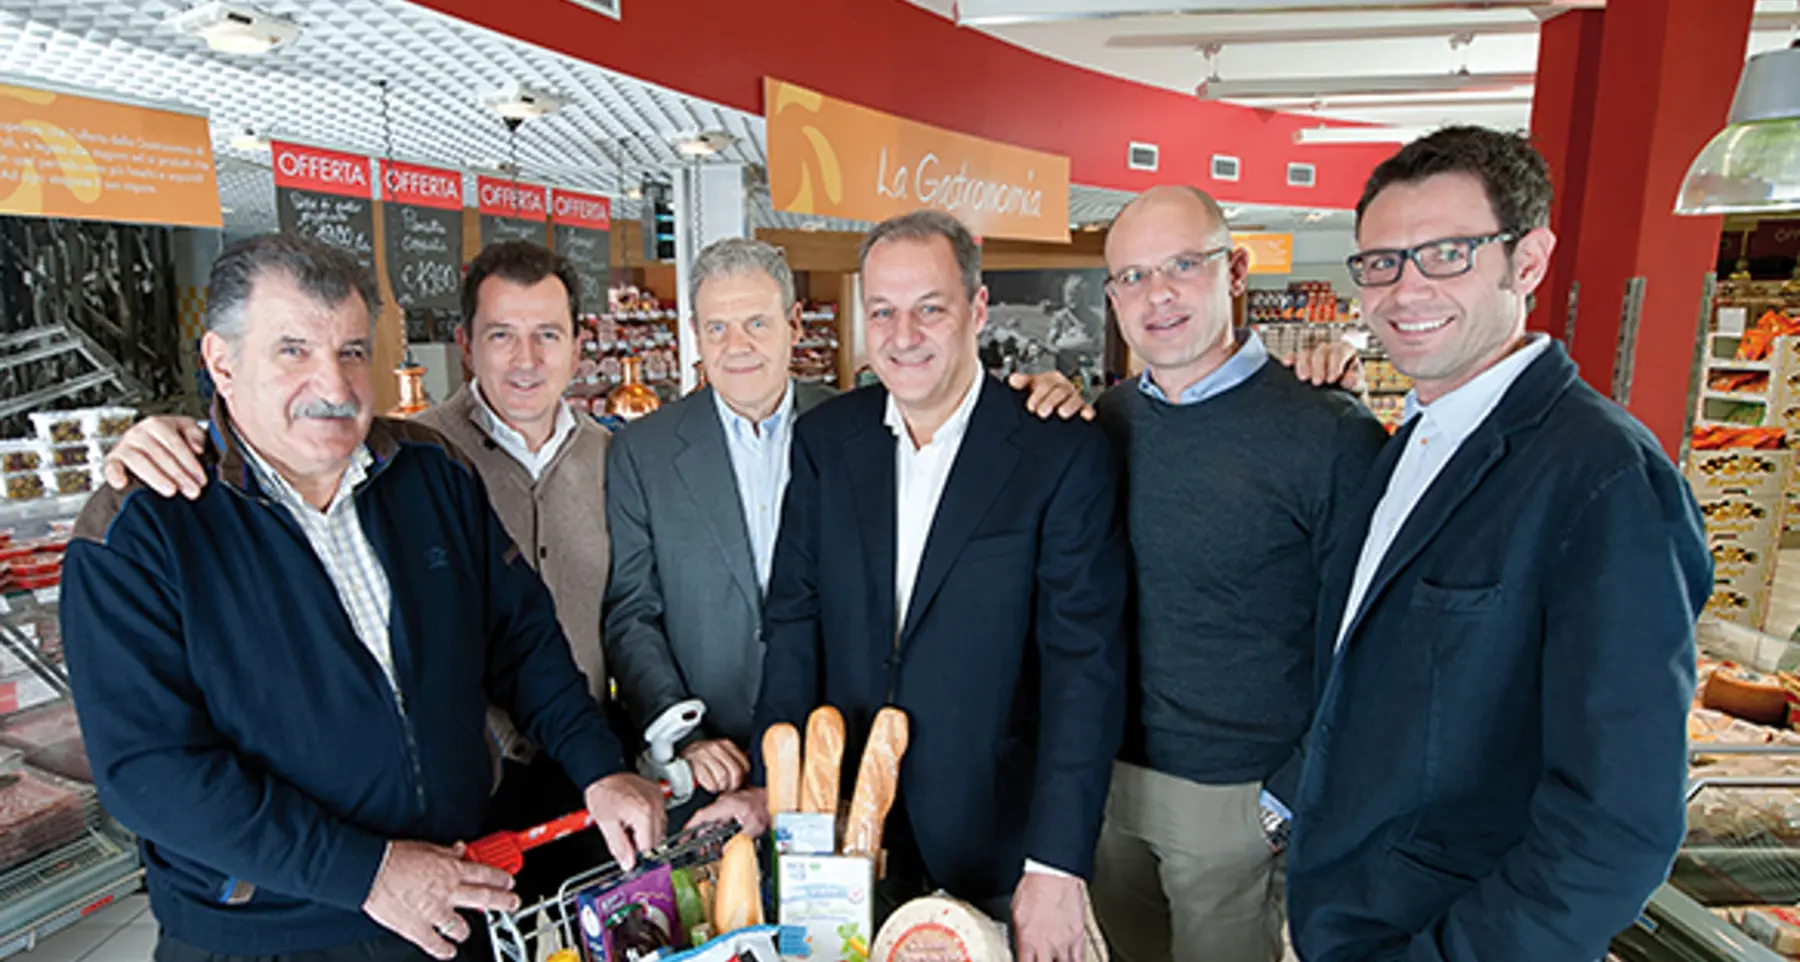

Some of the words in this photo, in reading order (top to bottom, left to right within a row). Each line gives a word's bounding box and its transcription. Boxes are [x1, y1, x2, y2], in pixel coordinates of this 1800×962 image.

[278, 152, 367, 186] OFFERTA
[385, 169, 459, 198] OFFERTA
[876, 146, 908, 200] La
[915, 153, 1042, 218] Gastronomia
[480, 184, 543, 211] OFFERTA
[555, 196, 608, 222] OFFERTA
